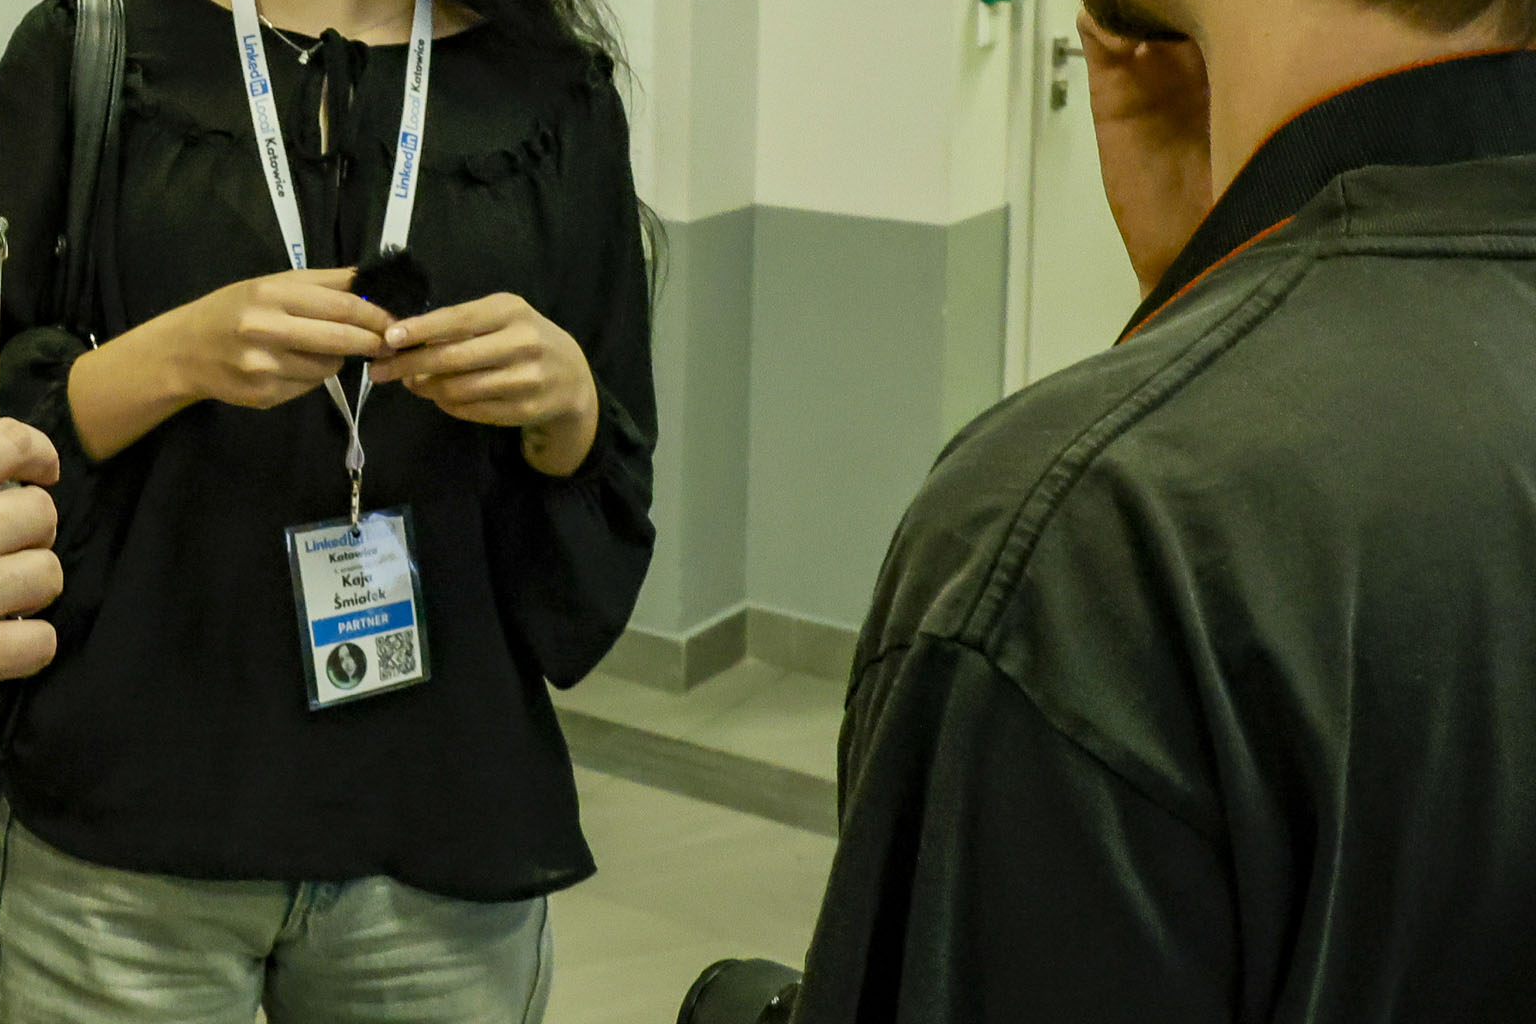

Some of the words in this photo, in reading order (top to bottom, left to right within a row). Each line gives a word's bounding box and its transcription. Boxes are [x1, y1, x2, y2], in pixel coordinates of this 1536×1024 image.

[411, 38, 425, 93] Katowice
[265, 137, 285, 198] Katowice
[338, 612, 389, 635] PARTNER
